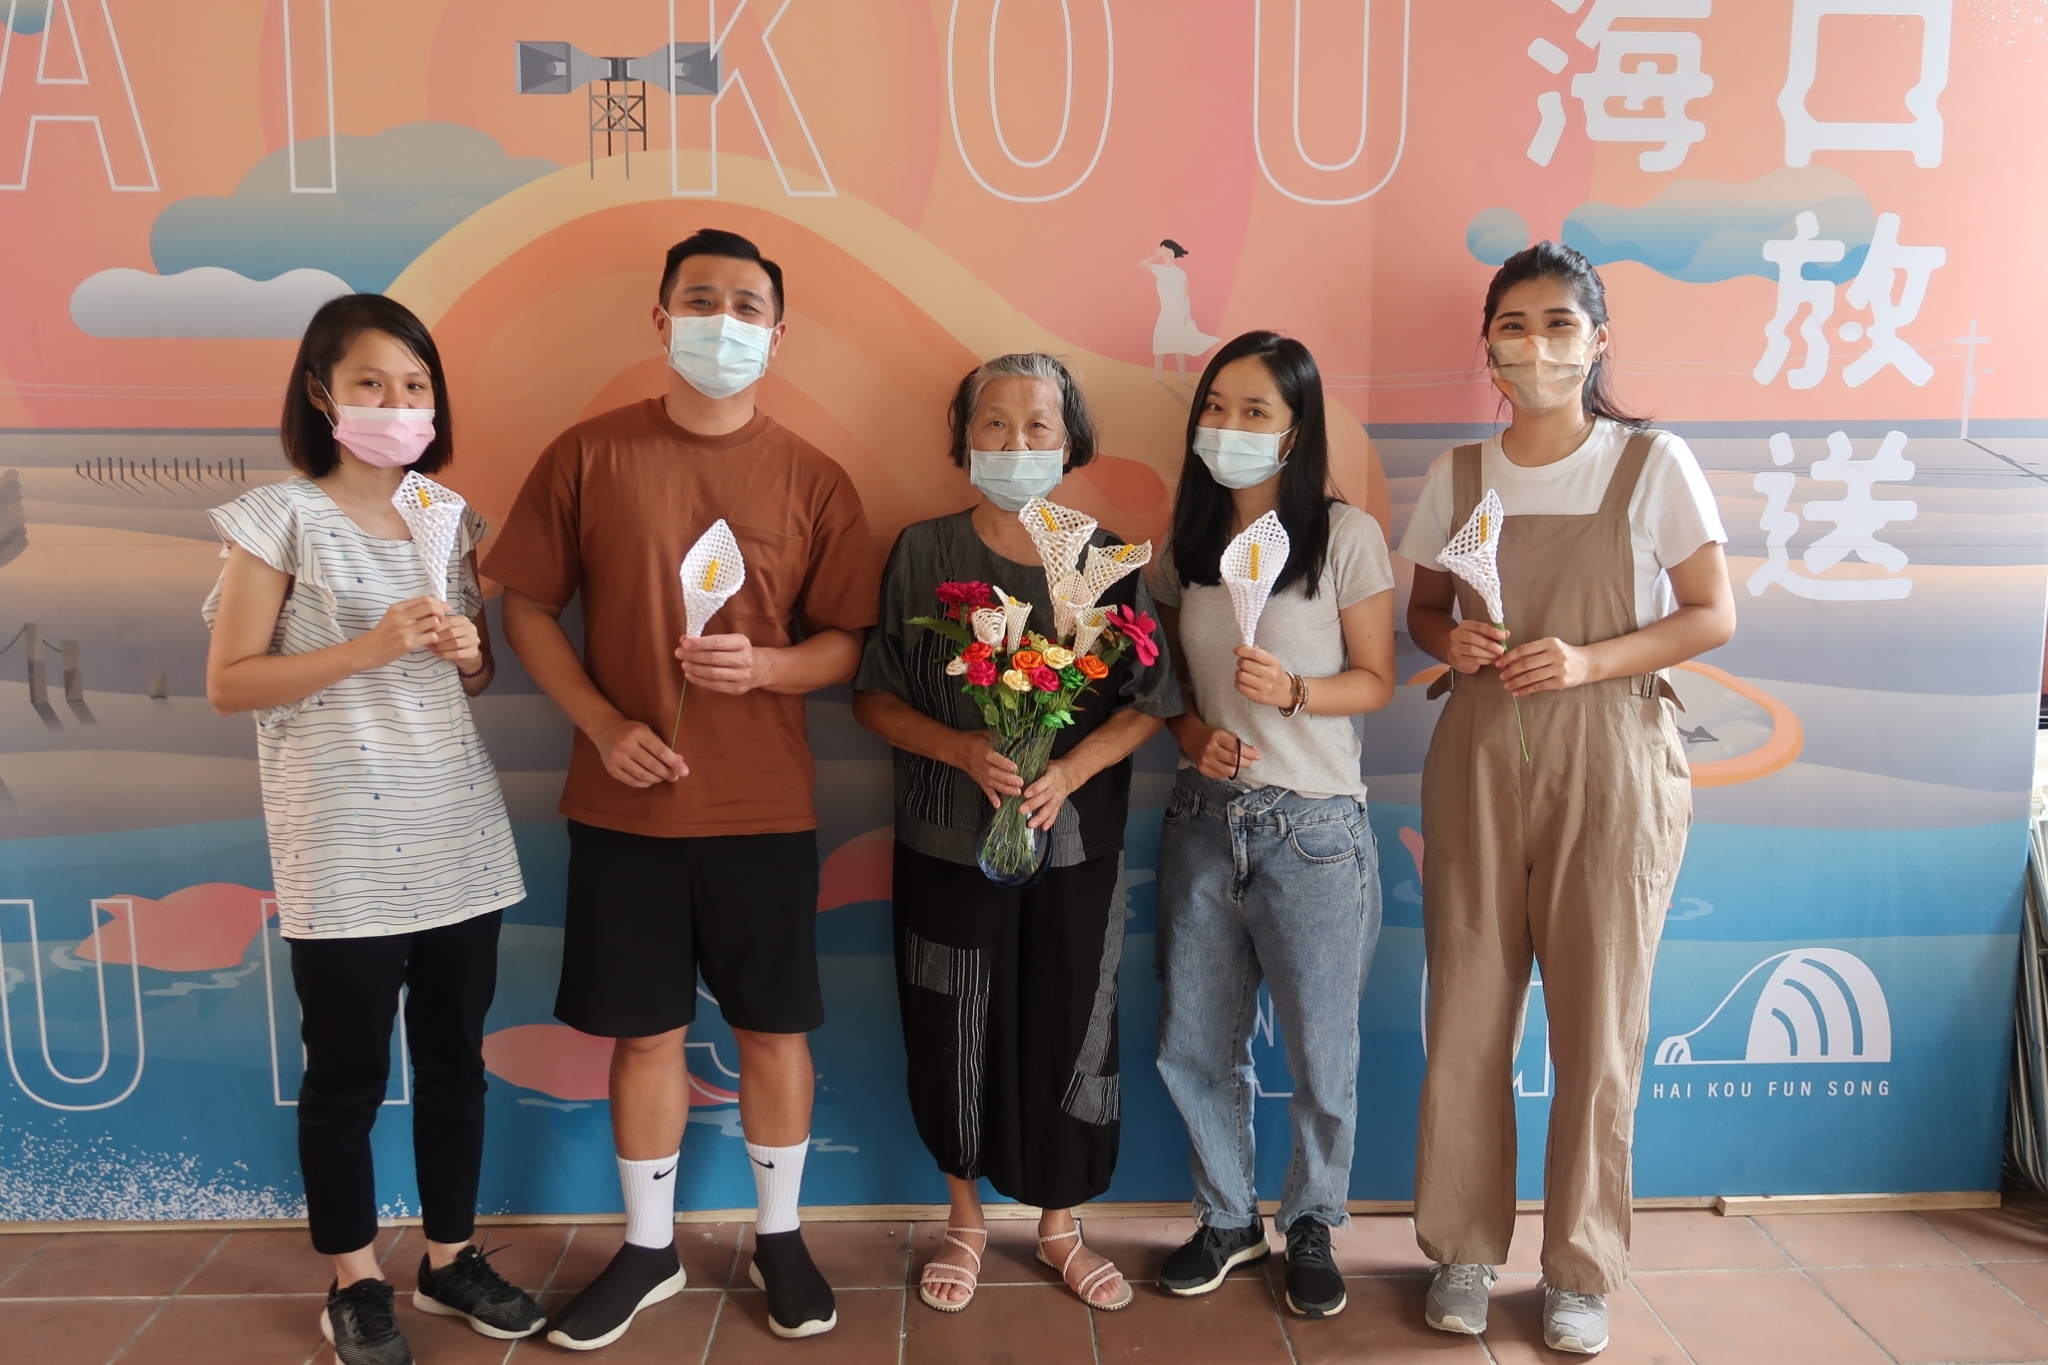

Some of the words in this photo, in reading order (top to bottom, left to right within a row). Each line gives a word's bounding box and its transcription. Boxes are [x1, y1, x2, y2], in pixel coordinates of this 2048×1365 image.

[669, 0, 1410, 206] KOU
[1653, 1083, 1692, 1099] HAI
[1708, 1082, 1752, 1098] KOU
[1768, 1081, 1812, 1097] FUN
[1827, 1080, 1890, 1097] SONG
